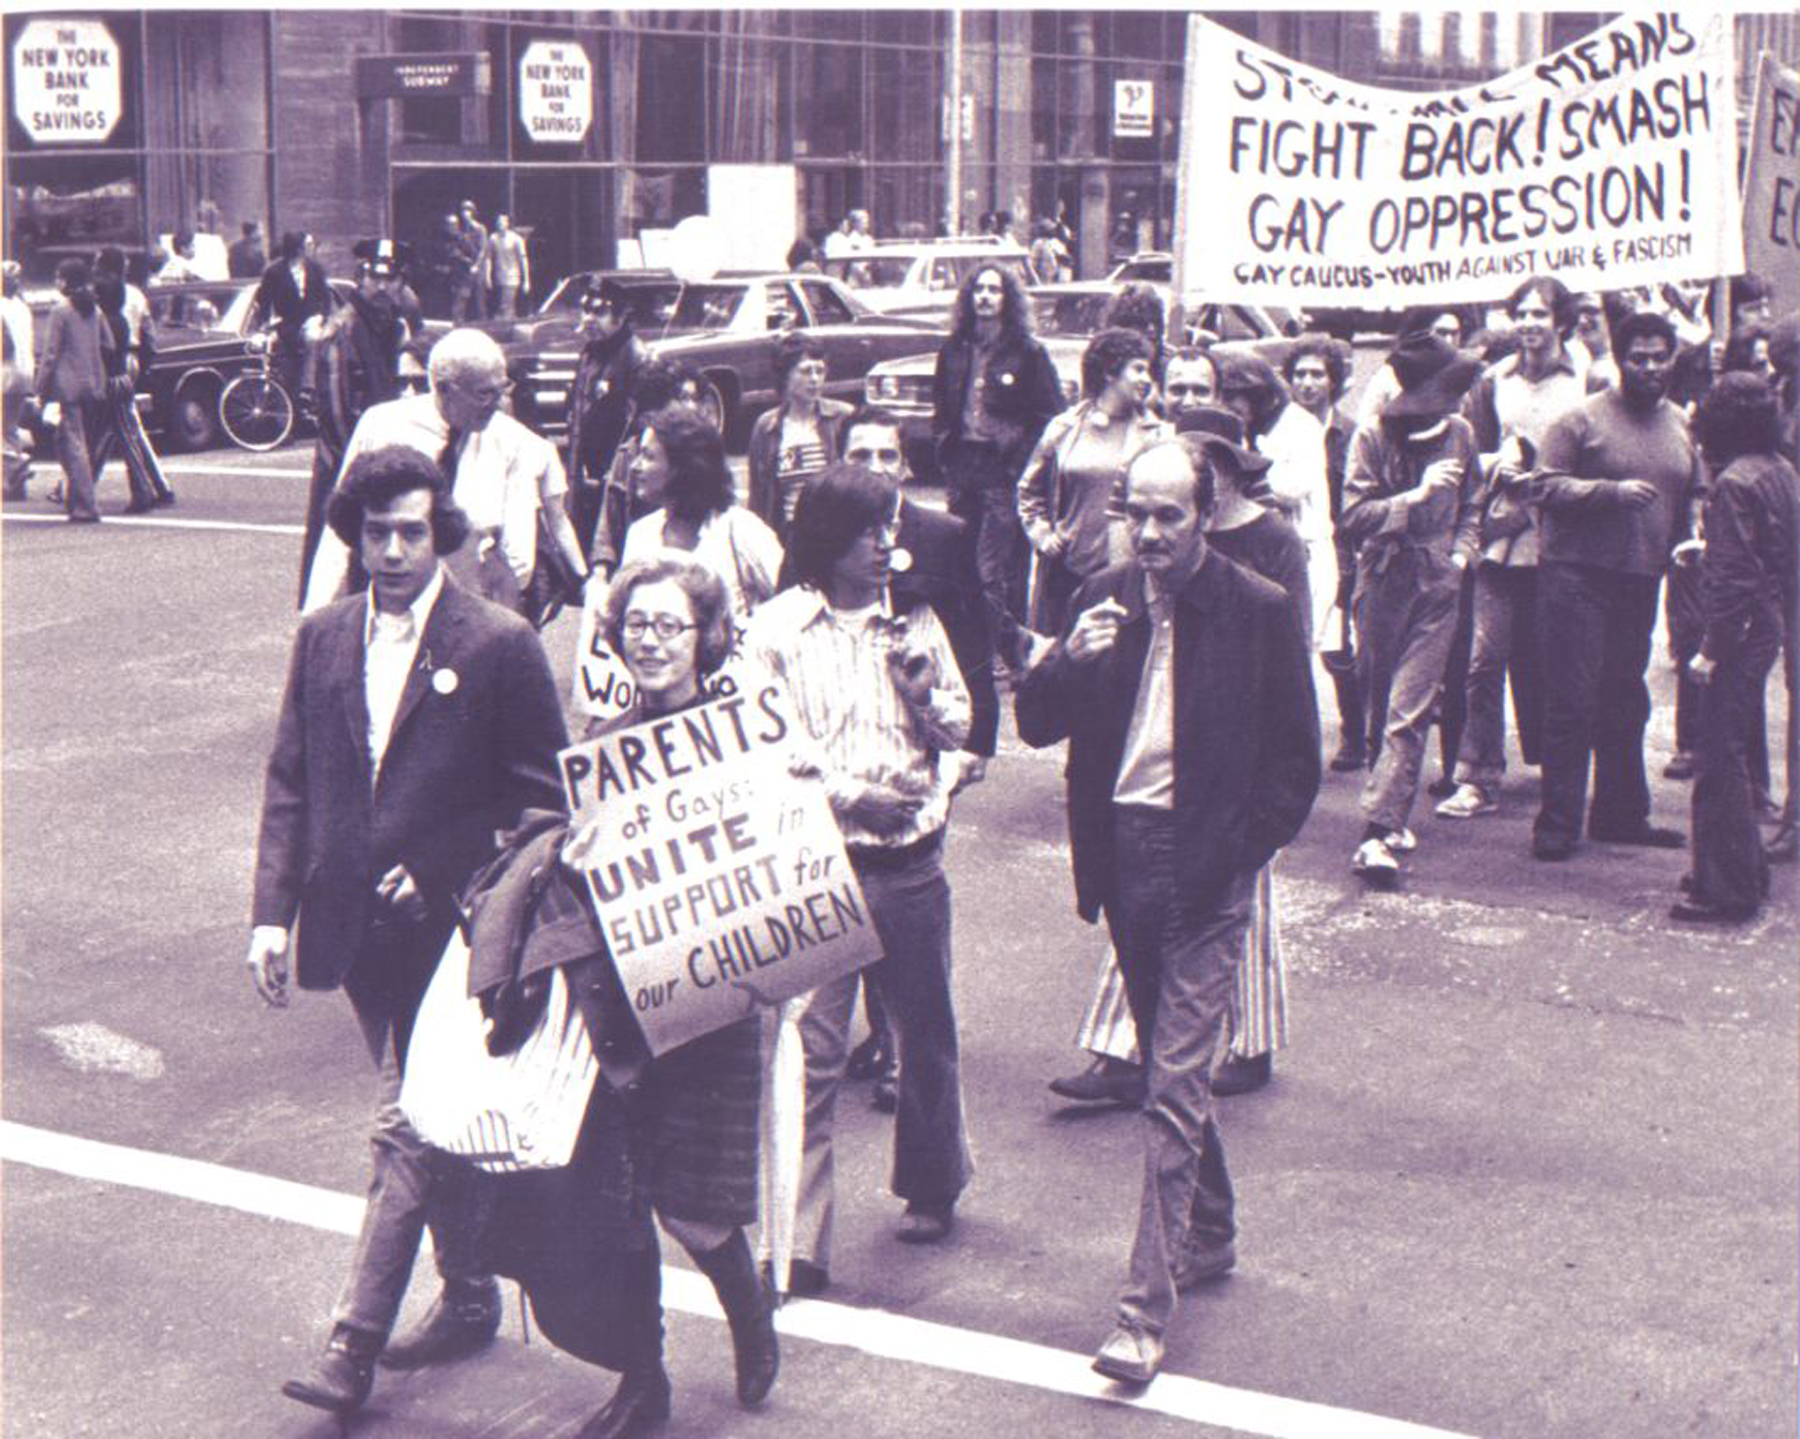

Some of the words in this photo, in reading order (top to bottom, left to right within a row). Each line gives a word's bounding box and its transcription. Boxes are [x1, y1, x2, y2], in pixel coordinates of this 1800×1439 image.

[22, 48, 58, 67] NEW
[65, 48, 109, 67] YORK
[526, 65, 550, 80] NEW
[555, 65, 585, 81] YORK
[1535, 12, 1696, 88] MEANS
[44, 71, 89, 89] BANK
[57, 93, 79, 107] FOR
[541, 83, 571, 99] BANK
[33, 111, 106, 131] SAVINGS
[532, 116, 582, 133] SAVINGS
[1228, 115, 1378, 180] FIGHT
[1400, 98, 1552, 182] BACK!
[1559, 70, 1711, 162] SMASH
[1247, 193, 1346, 255] GAY
[1368, 148, 1692, 254] OPPRESSION!
[1289, 259, 1452, 288] CAUCUS-YOUTH
[1455, 249, 1536, 281] AGAINST
[1612, 232, 1692, 264] FASCISM
[564, 686, 788, 810] PARENTS
[621, 803, 651, 840] of
[589, 812, 757, 903] UNITE
[777, 803, 806, 836] in
[610, 854, 782, 956] SUPPORT
[794, 847, 837, 887] for
[636, 977, 680, 1012] our
[687, 883, 865, 989] CHILDREN
